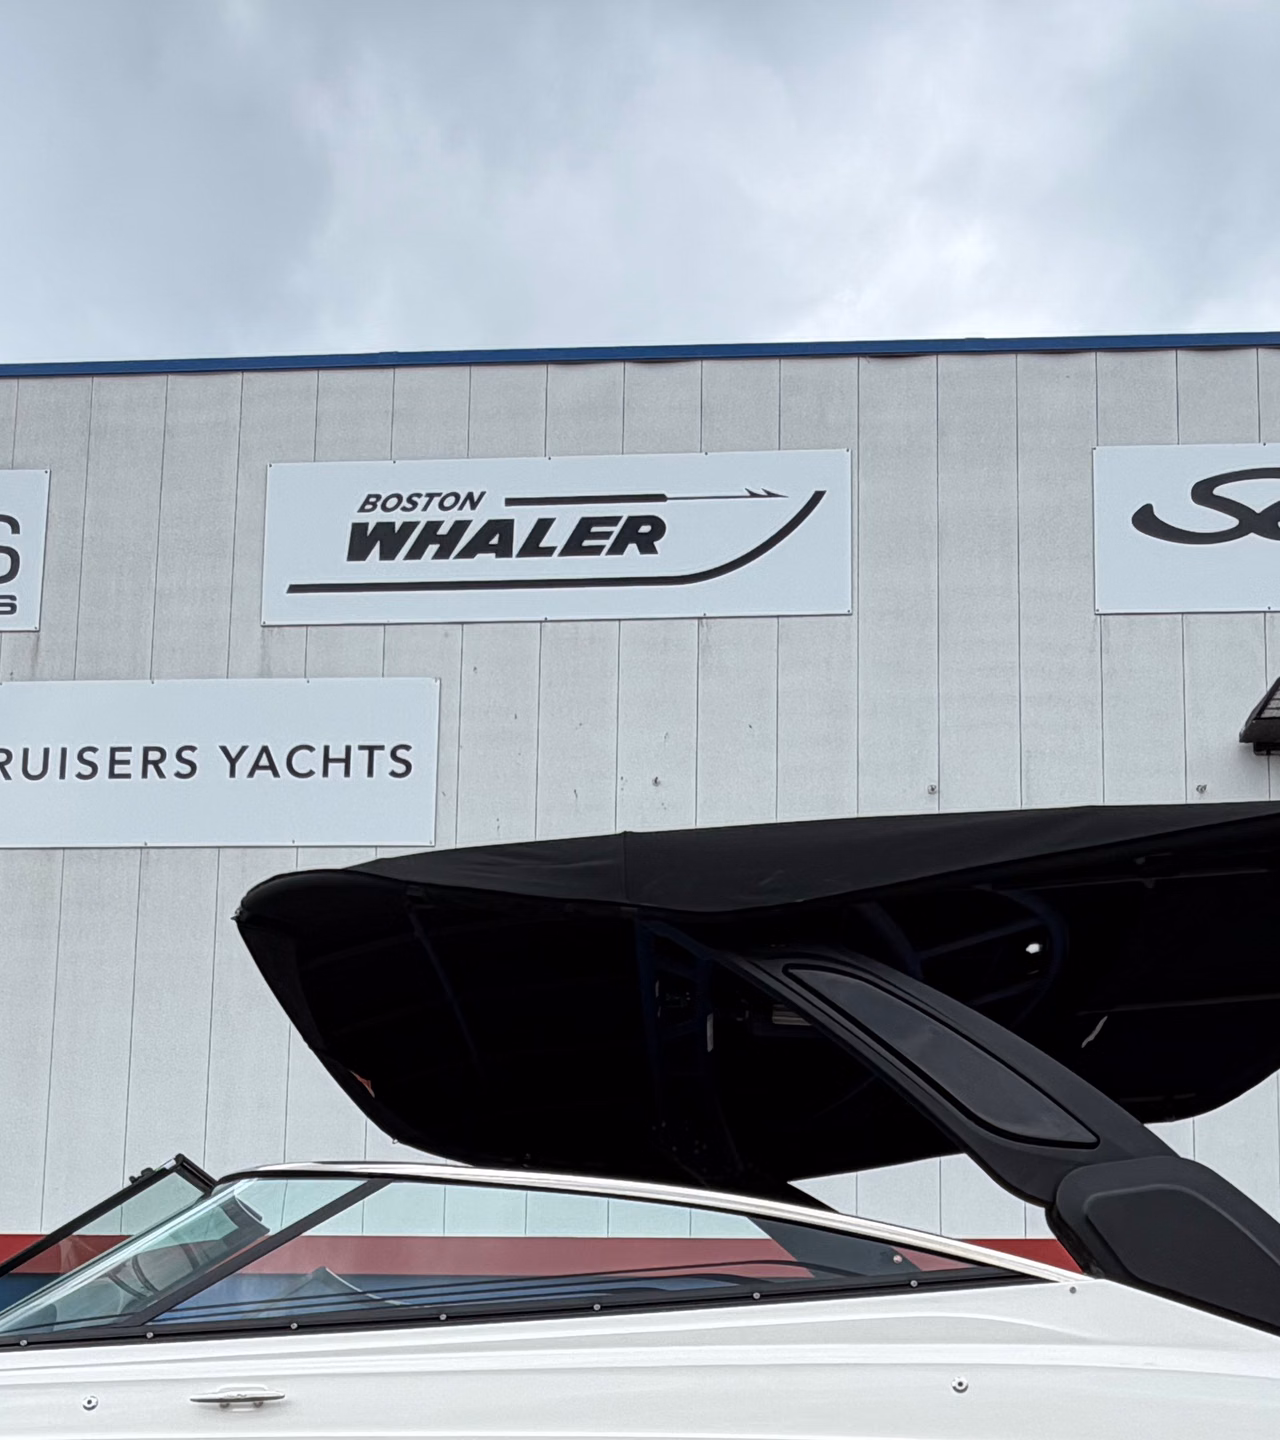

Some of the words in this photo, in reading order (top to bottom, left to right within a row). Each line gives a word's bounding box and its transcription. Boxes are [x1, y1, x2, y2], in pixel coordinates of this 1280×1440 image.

[357, 491, 487, 513] BOSTON
[346, 514, 667, 562] WHALER
[218, 744, 413, 779] YACHTS
